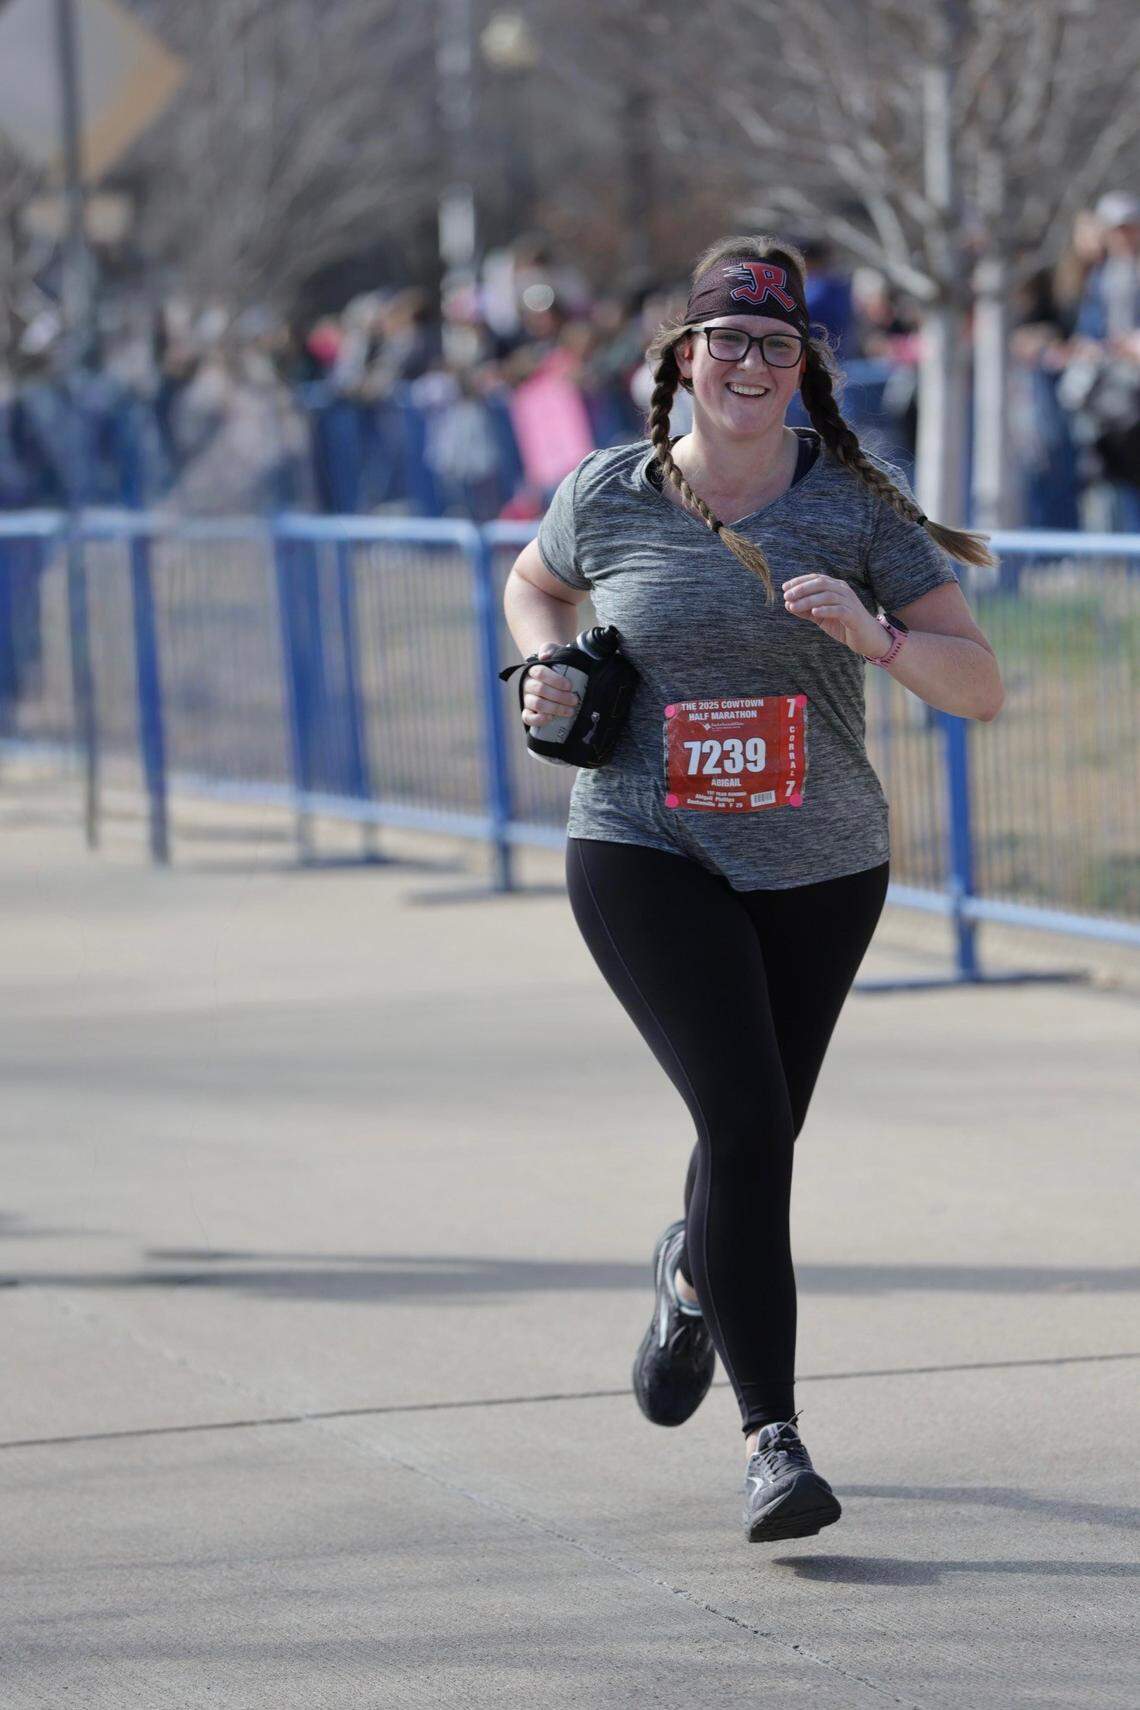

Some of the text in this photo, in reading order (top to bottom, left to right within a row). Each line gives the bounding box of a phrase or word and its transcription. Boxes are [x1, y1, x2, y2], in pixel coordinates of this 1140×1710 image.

[681, 699, 764, 711] THE 2025 COWTOWN
[688, 710, 758, 721] HALF MARATHON
[785, 699, 797, 797] 7 CORRAL 7
[683, 737, 766, 775] 7239
[711, 778, 742, 787] ABIGAIL
